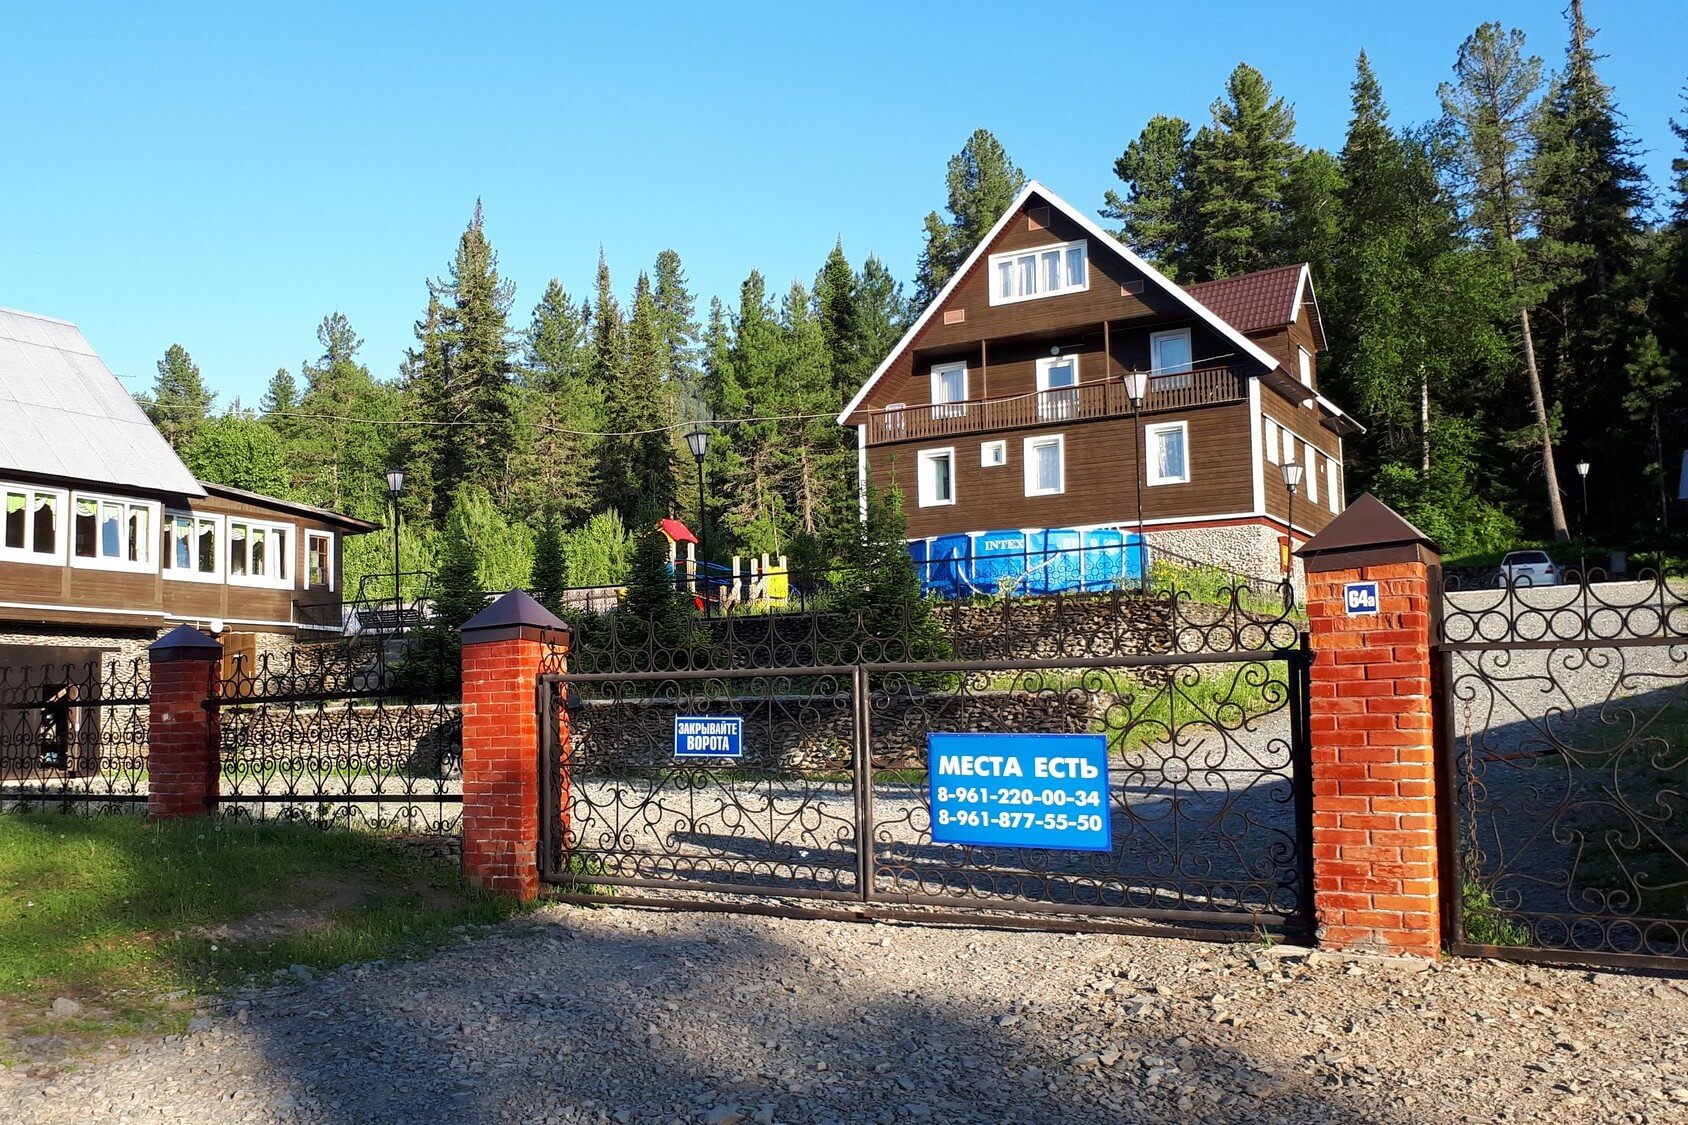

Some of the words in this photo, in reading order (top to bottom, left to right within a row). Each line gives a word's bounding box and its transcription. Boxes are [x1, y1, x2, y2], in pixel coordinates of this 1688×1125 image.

[985, 539, 1025, 551] INTEX
[1348, 589, 1376, 608] 64а
[678, 721, 738, 735] ЗАКРЫВАЙТЕ
[686, 735, 730, 751] ВОРОТА
[938, 755, 1024, 777] МЕСТА
[1034, 757, 1099, 779] ЕСТЬ
[937, 786, 1100, 807] 8-961-220-00-34
[938, 809, 1103, 832] 8-961-877-55-50
